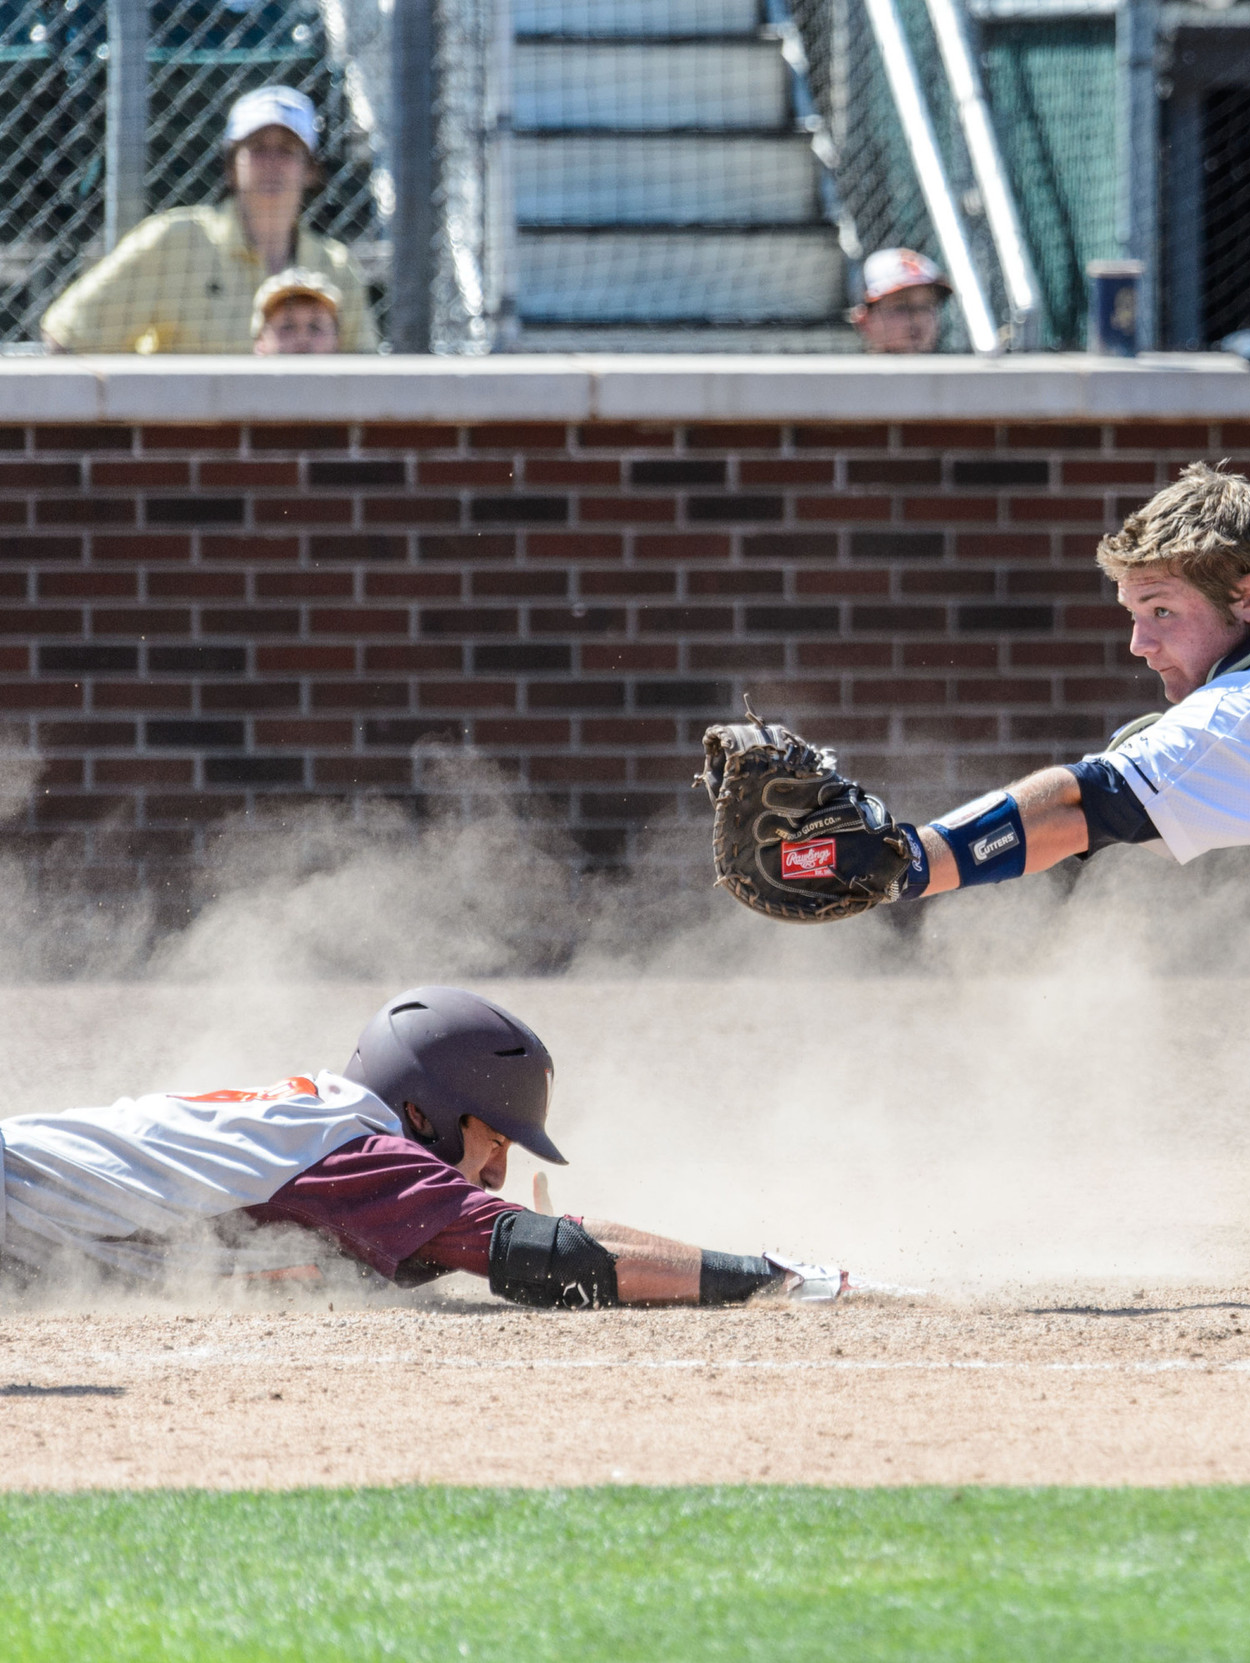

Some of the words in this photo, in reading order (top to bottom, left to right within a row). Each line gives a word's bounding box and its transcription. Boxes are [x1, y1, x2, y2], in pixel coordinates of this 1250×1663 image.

[801, 820, 824, 835] GLOVE
[973, 833, 1014, 861] CUTTERS
[786, 848, 831, 869] Rawlings
